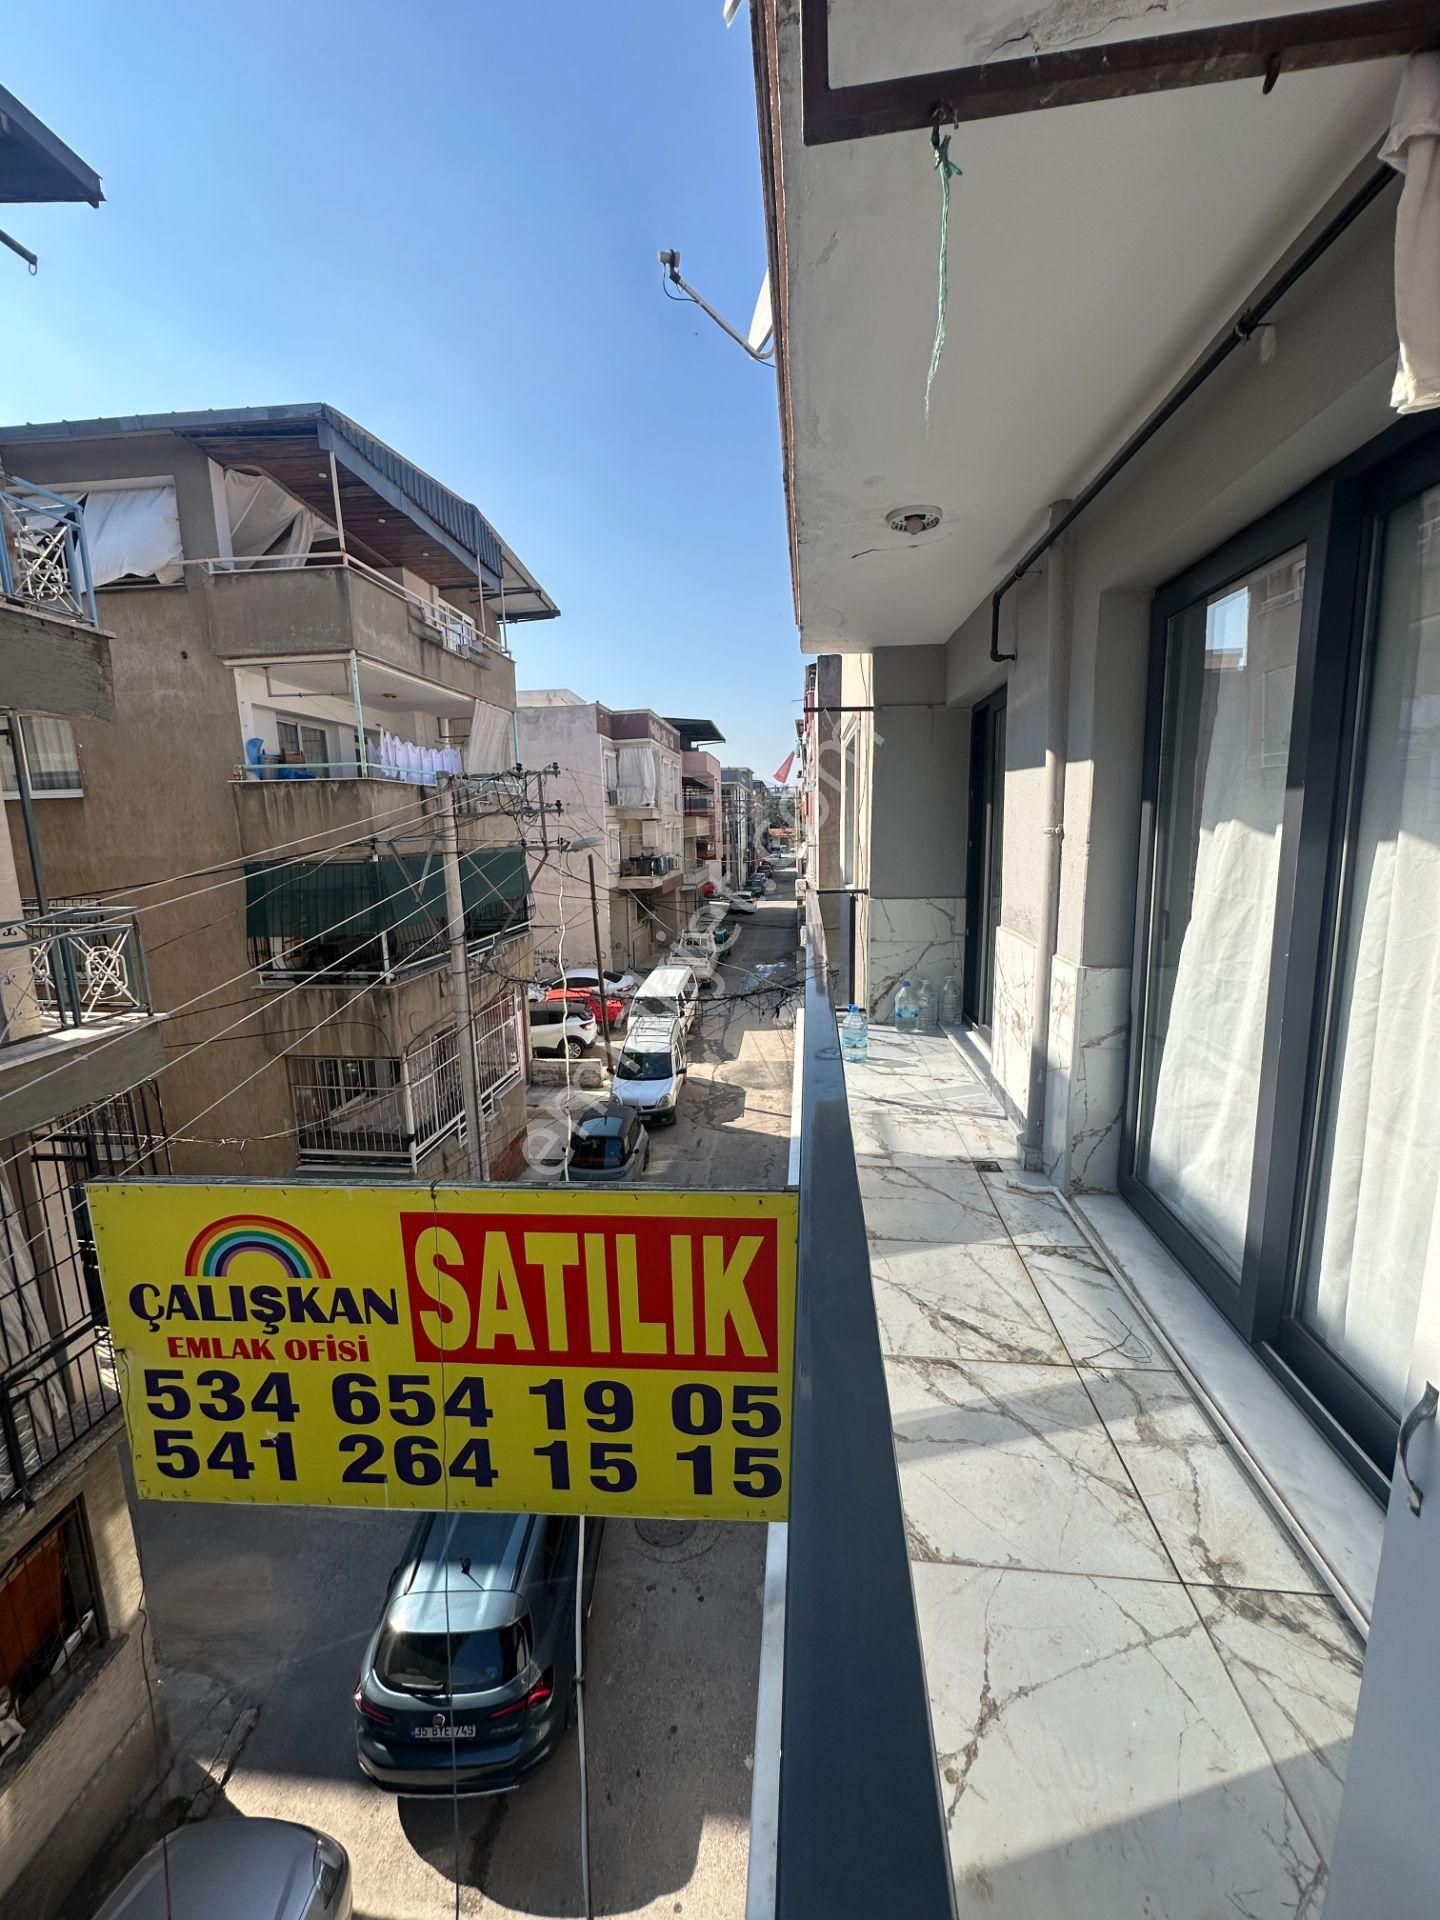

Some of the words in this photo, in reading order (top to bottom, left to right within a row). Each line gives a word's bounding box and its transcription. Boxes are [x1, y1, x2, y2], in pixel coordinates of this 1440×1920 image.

[129, 1282, 399, 1334] ÇALIŞKAN
[413, 1226, 769, 1358] SATILIK
[167, 1335, 275, 1361] EMLAK
[284, 1333, 370, 1363] OFİSİ
[144, 1368, 301, 1423] 534
[331, 1373, 494, 1428] 654
[528, 1378, 636, 1435] 19
[671, 1382, 782, 1438] 05
[153, 1430, 299, 1482] 541
[338, 1434, 500, 1488] 264
[533, 1439, 638, 1494] 15
[675, 1444, 783, 1499] 15
